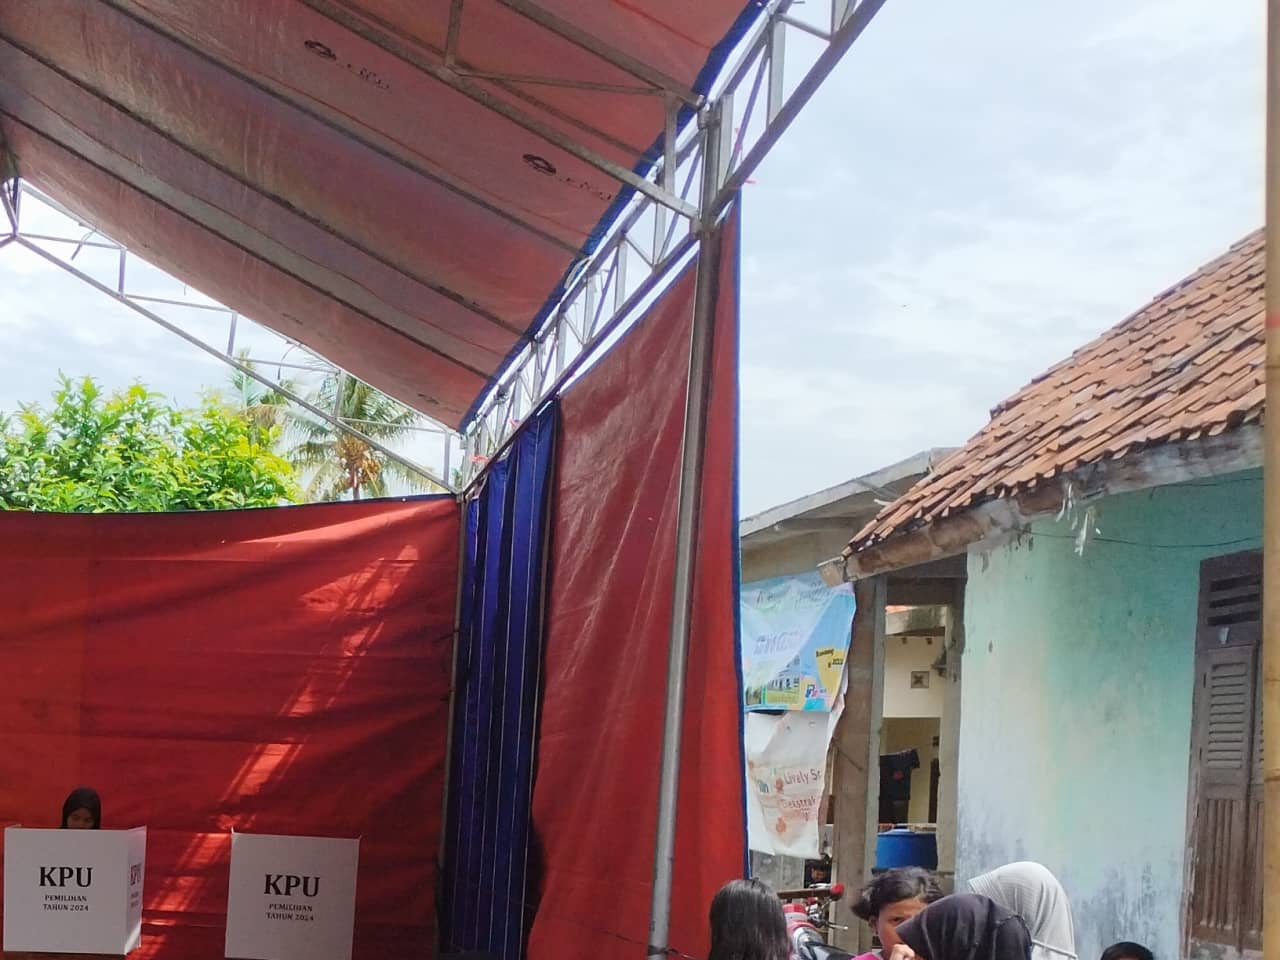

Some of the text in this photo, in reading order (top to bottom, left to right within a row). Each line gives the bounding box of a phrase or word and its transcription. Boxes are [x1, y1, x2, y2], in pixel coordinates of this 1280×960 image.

[39, 866, 93, 888] KPU
[263, 874, 321, 898] KPU
[44, 894, 88, 902] PEMILIHAN
[42, 903, 89, 912] TAHUN 2024
[268, 903, 313, 912] PEMILIHAN
[266, 912, 315, 922] TAHUN 2024
